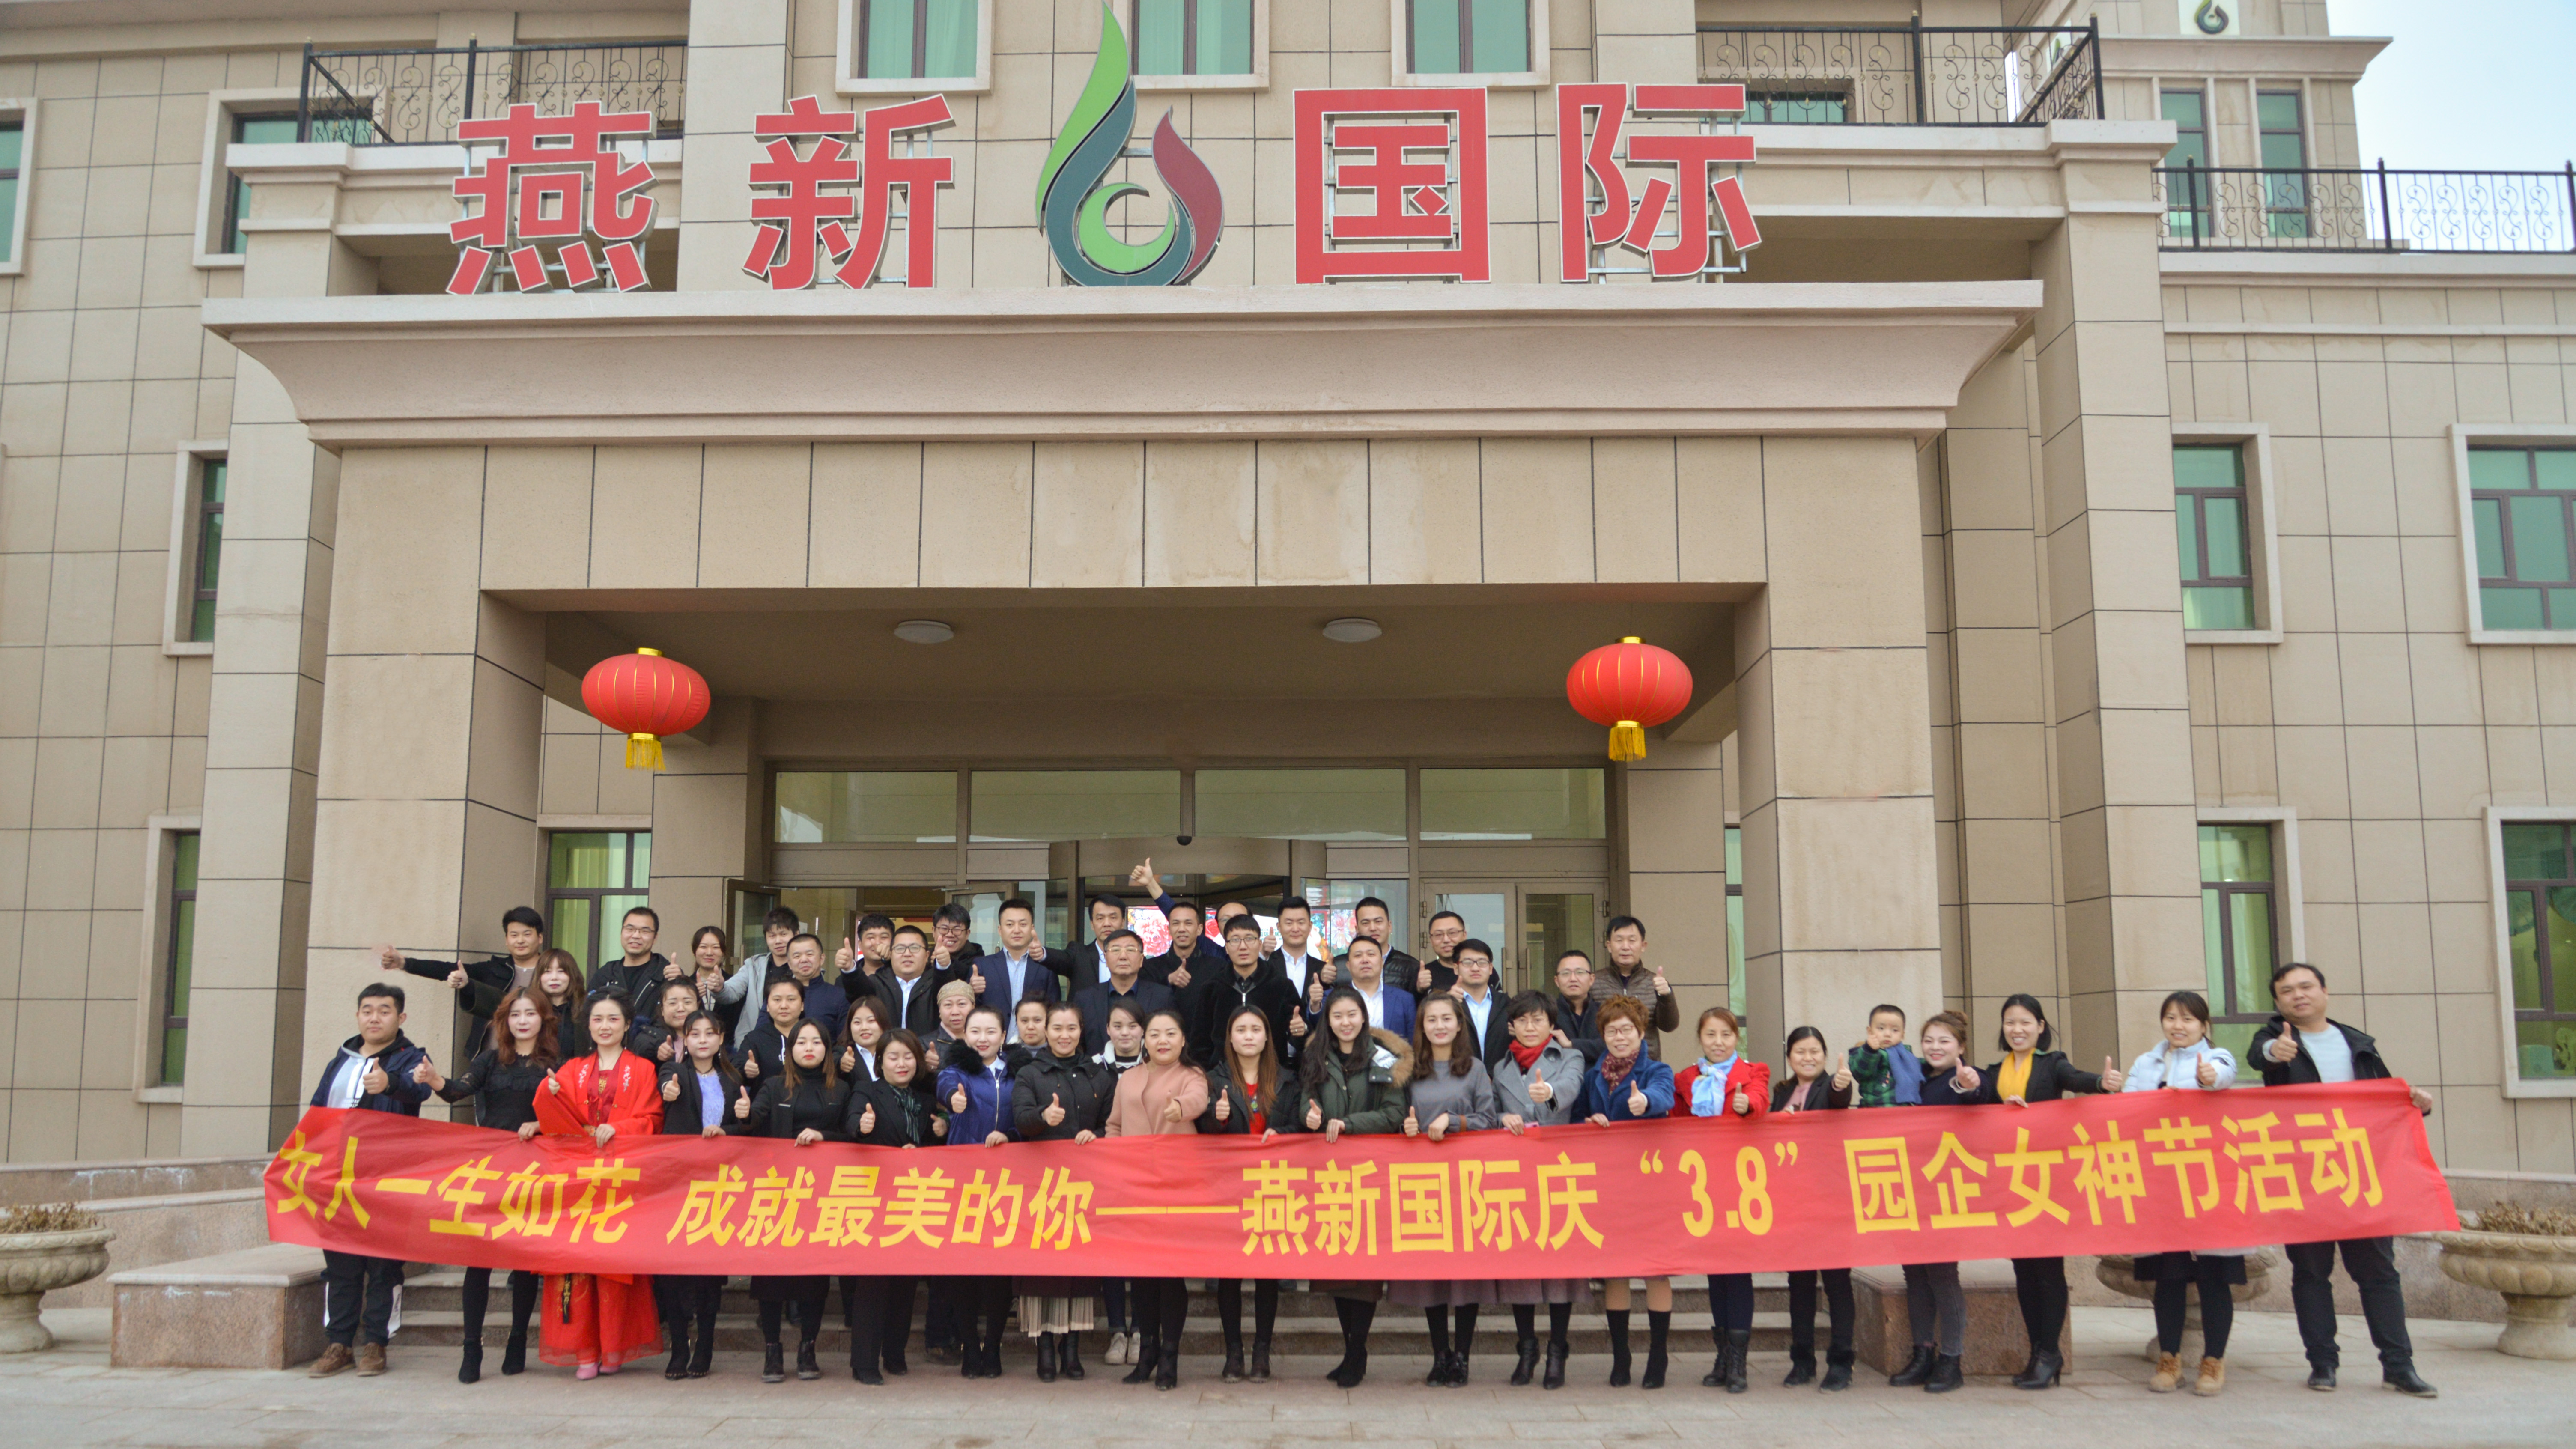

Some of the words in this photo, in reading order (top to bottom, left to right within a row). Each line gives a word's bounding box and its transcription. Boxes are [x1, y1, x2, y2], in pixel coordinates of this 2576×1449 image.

[276, 1129, 641, 1244] 女人一生如花
[1843, 1108, 2382, 1233] 园企女神节活动
